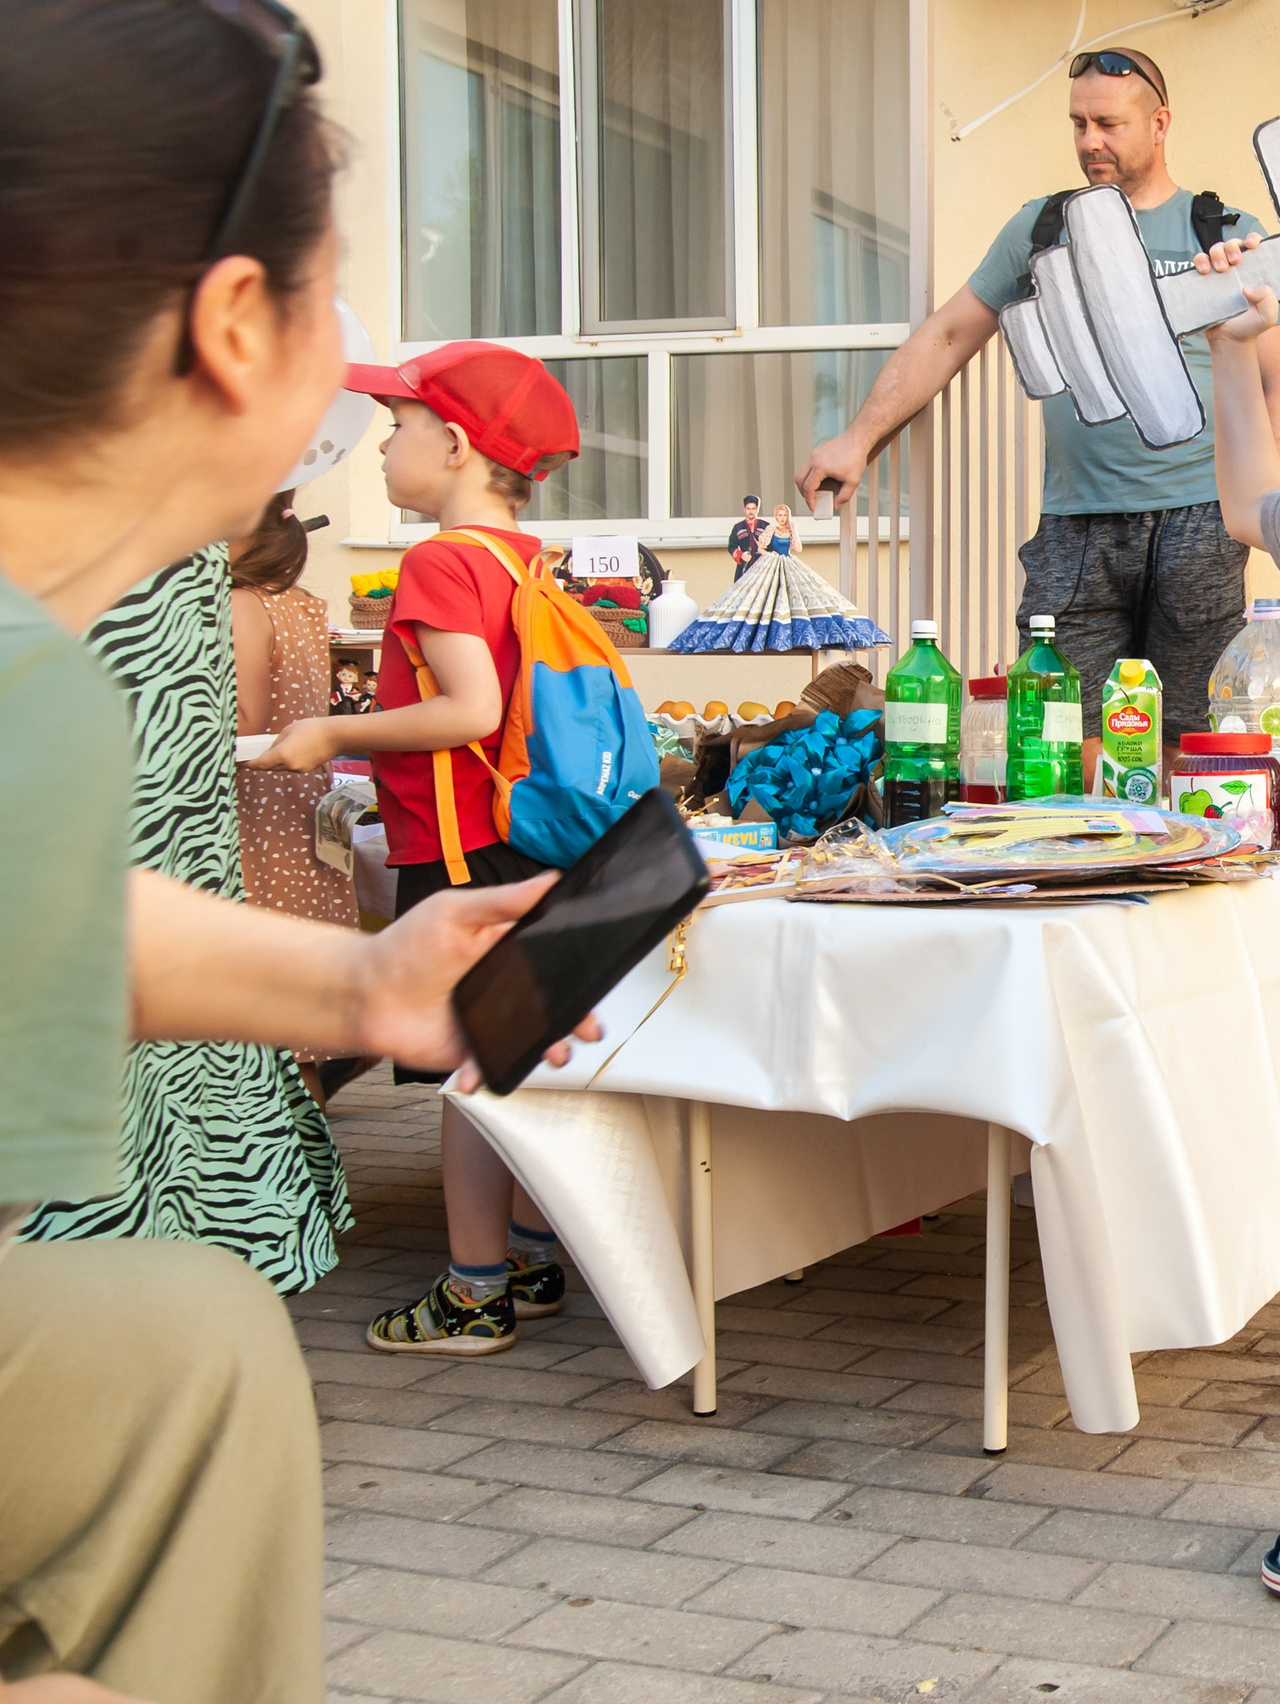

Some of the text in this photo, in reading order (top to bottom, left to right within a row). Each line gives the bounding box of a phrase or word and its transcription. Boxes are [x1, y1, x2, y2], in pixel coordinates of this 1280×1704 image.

[588, 555, 620, 573] 150
[1119, 712, 1141, 721] Сады
[1111, 719, 1148, 729] Придонья
[602, 751, 612, 764] KID
